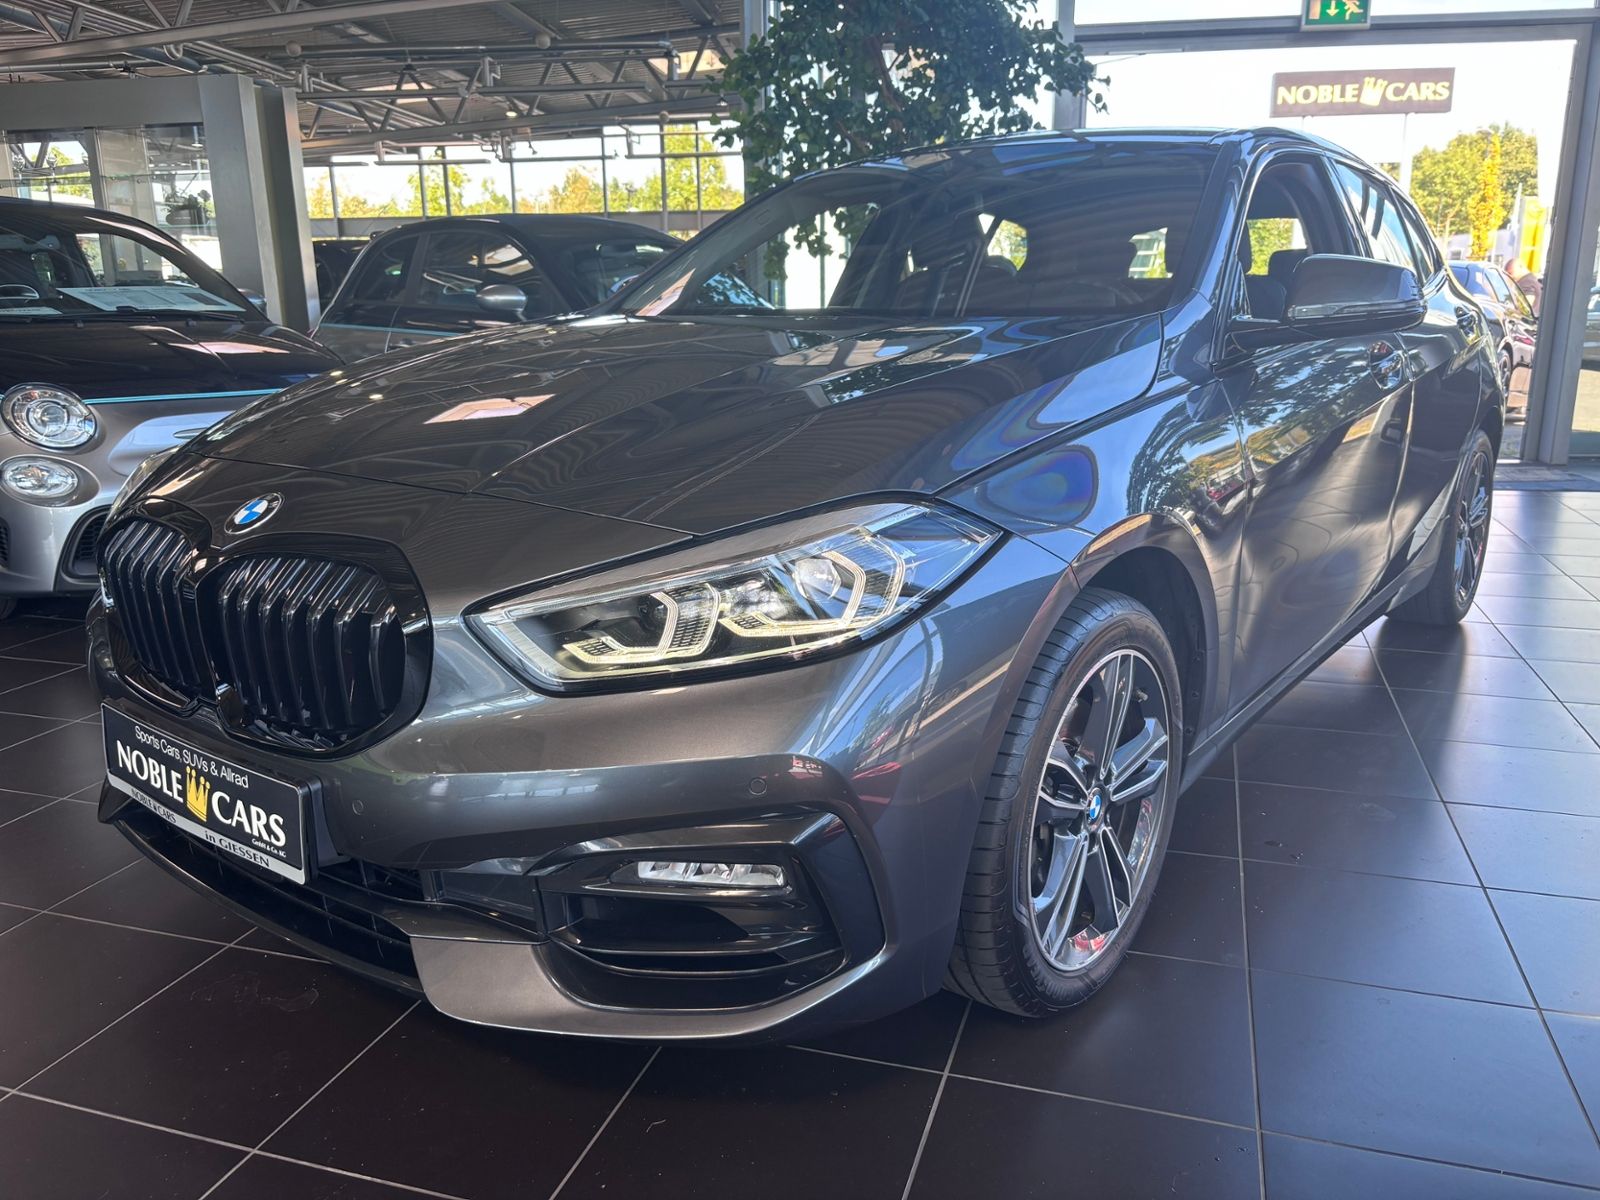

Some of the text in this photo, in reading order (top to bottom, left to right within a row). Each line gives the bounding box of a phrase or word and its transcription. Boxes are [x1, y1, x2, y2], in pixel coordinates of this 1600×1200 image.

[1277, 81, 1450, 105] NOBLE CARS
[134, 725, 249, 789] Sports Cars, SUVs & Allrad
[116, 740, 286, 847] NOBLE CARS
[156, 805, 177, 824] CARS
[204, 830, 216, 844] in
[219, 838, 270, 868] GIESSEN
